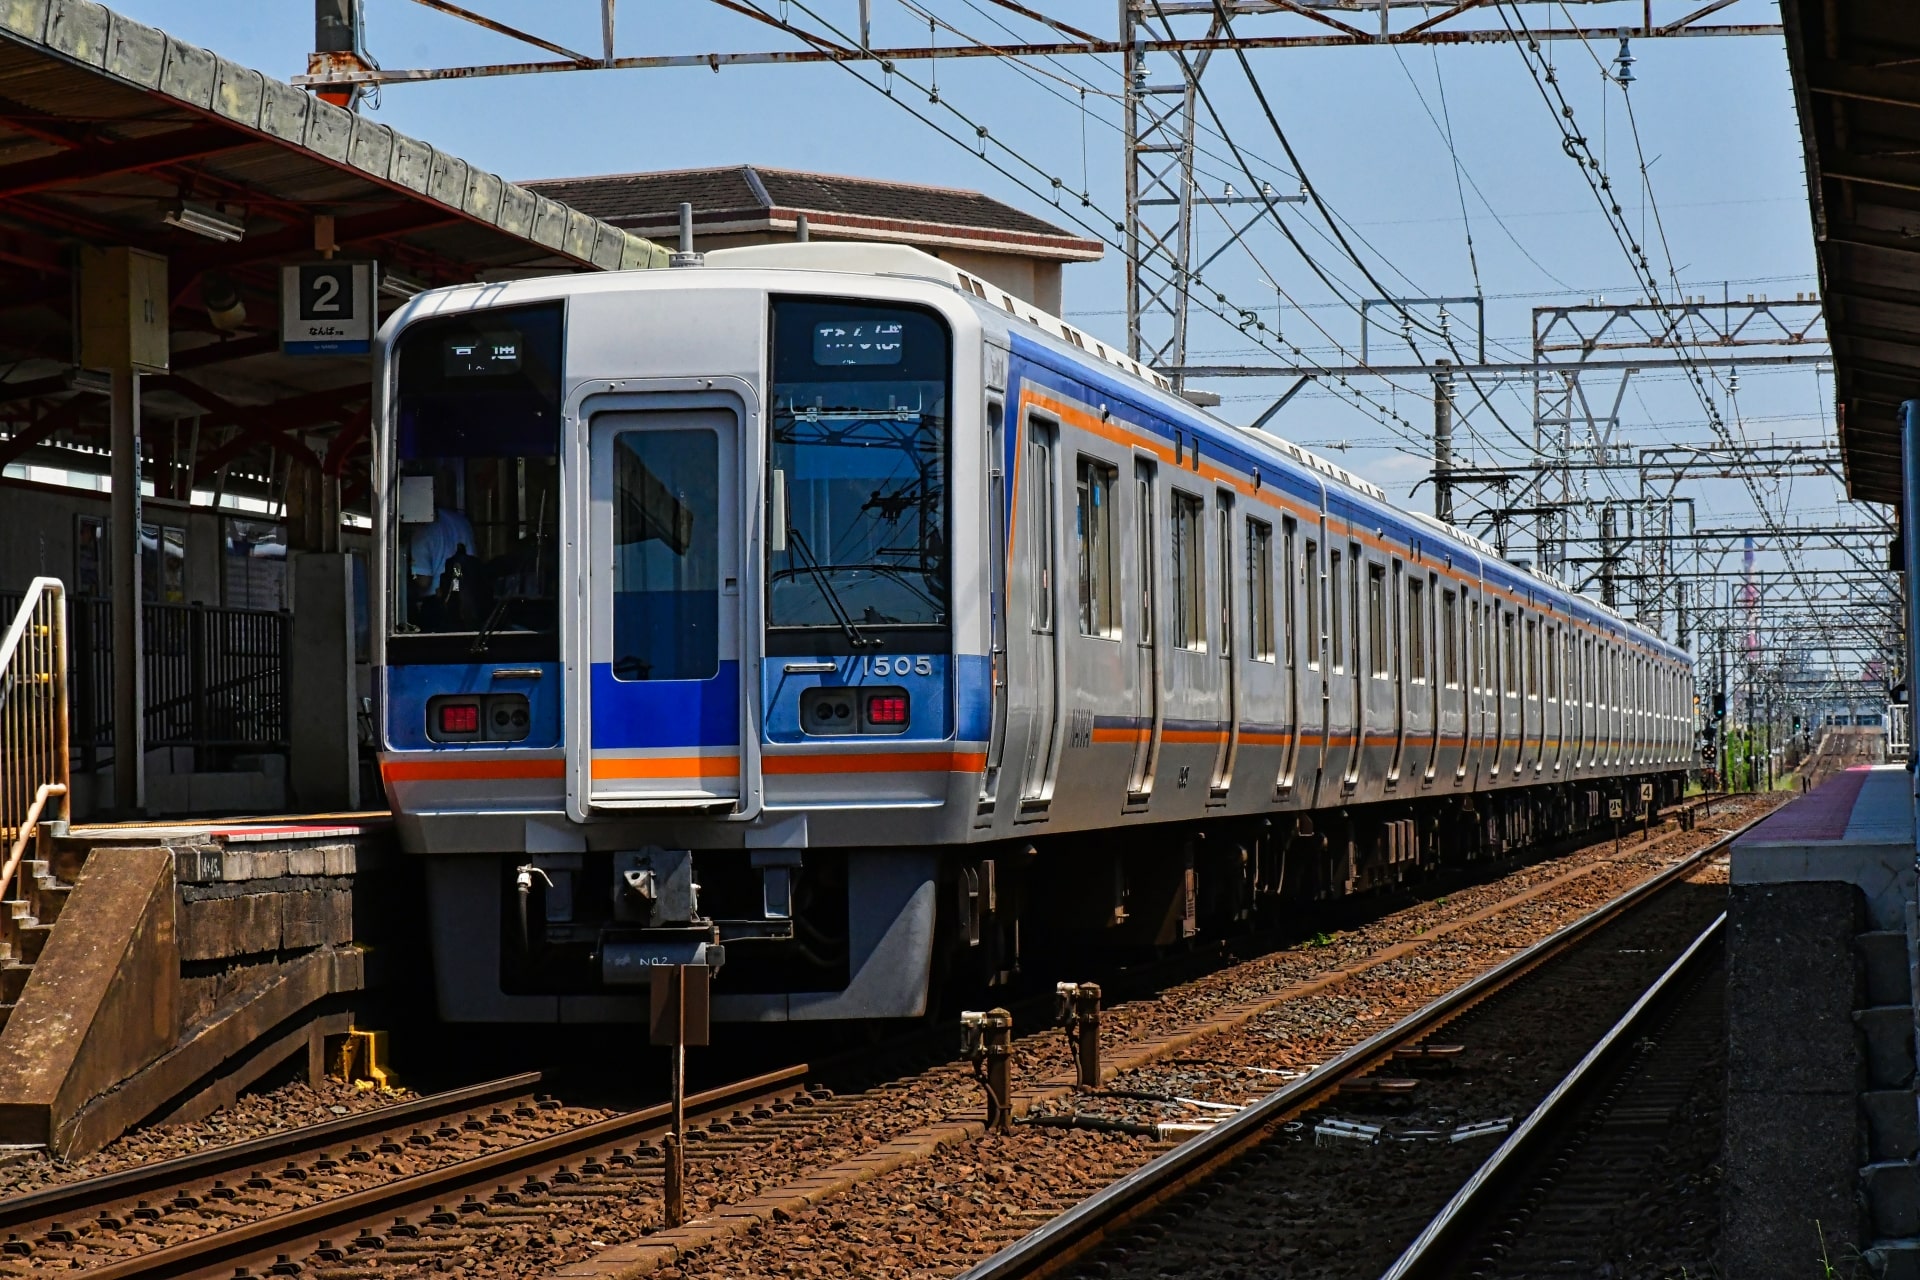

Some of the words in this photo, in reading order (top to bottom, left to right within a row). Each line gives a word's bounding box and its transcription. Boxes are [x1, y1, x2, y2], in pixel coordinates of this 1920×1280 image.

[312, 275, 340, 312] 2
[863, 656, 932, 676] 1505
[1642, 785, 1651, 799] 4
